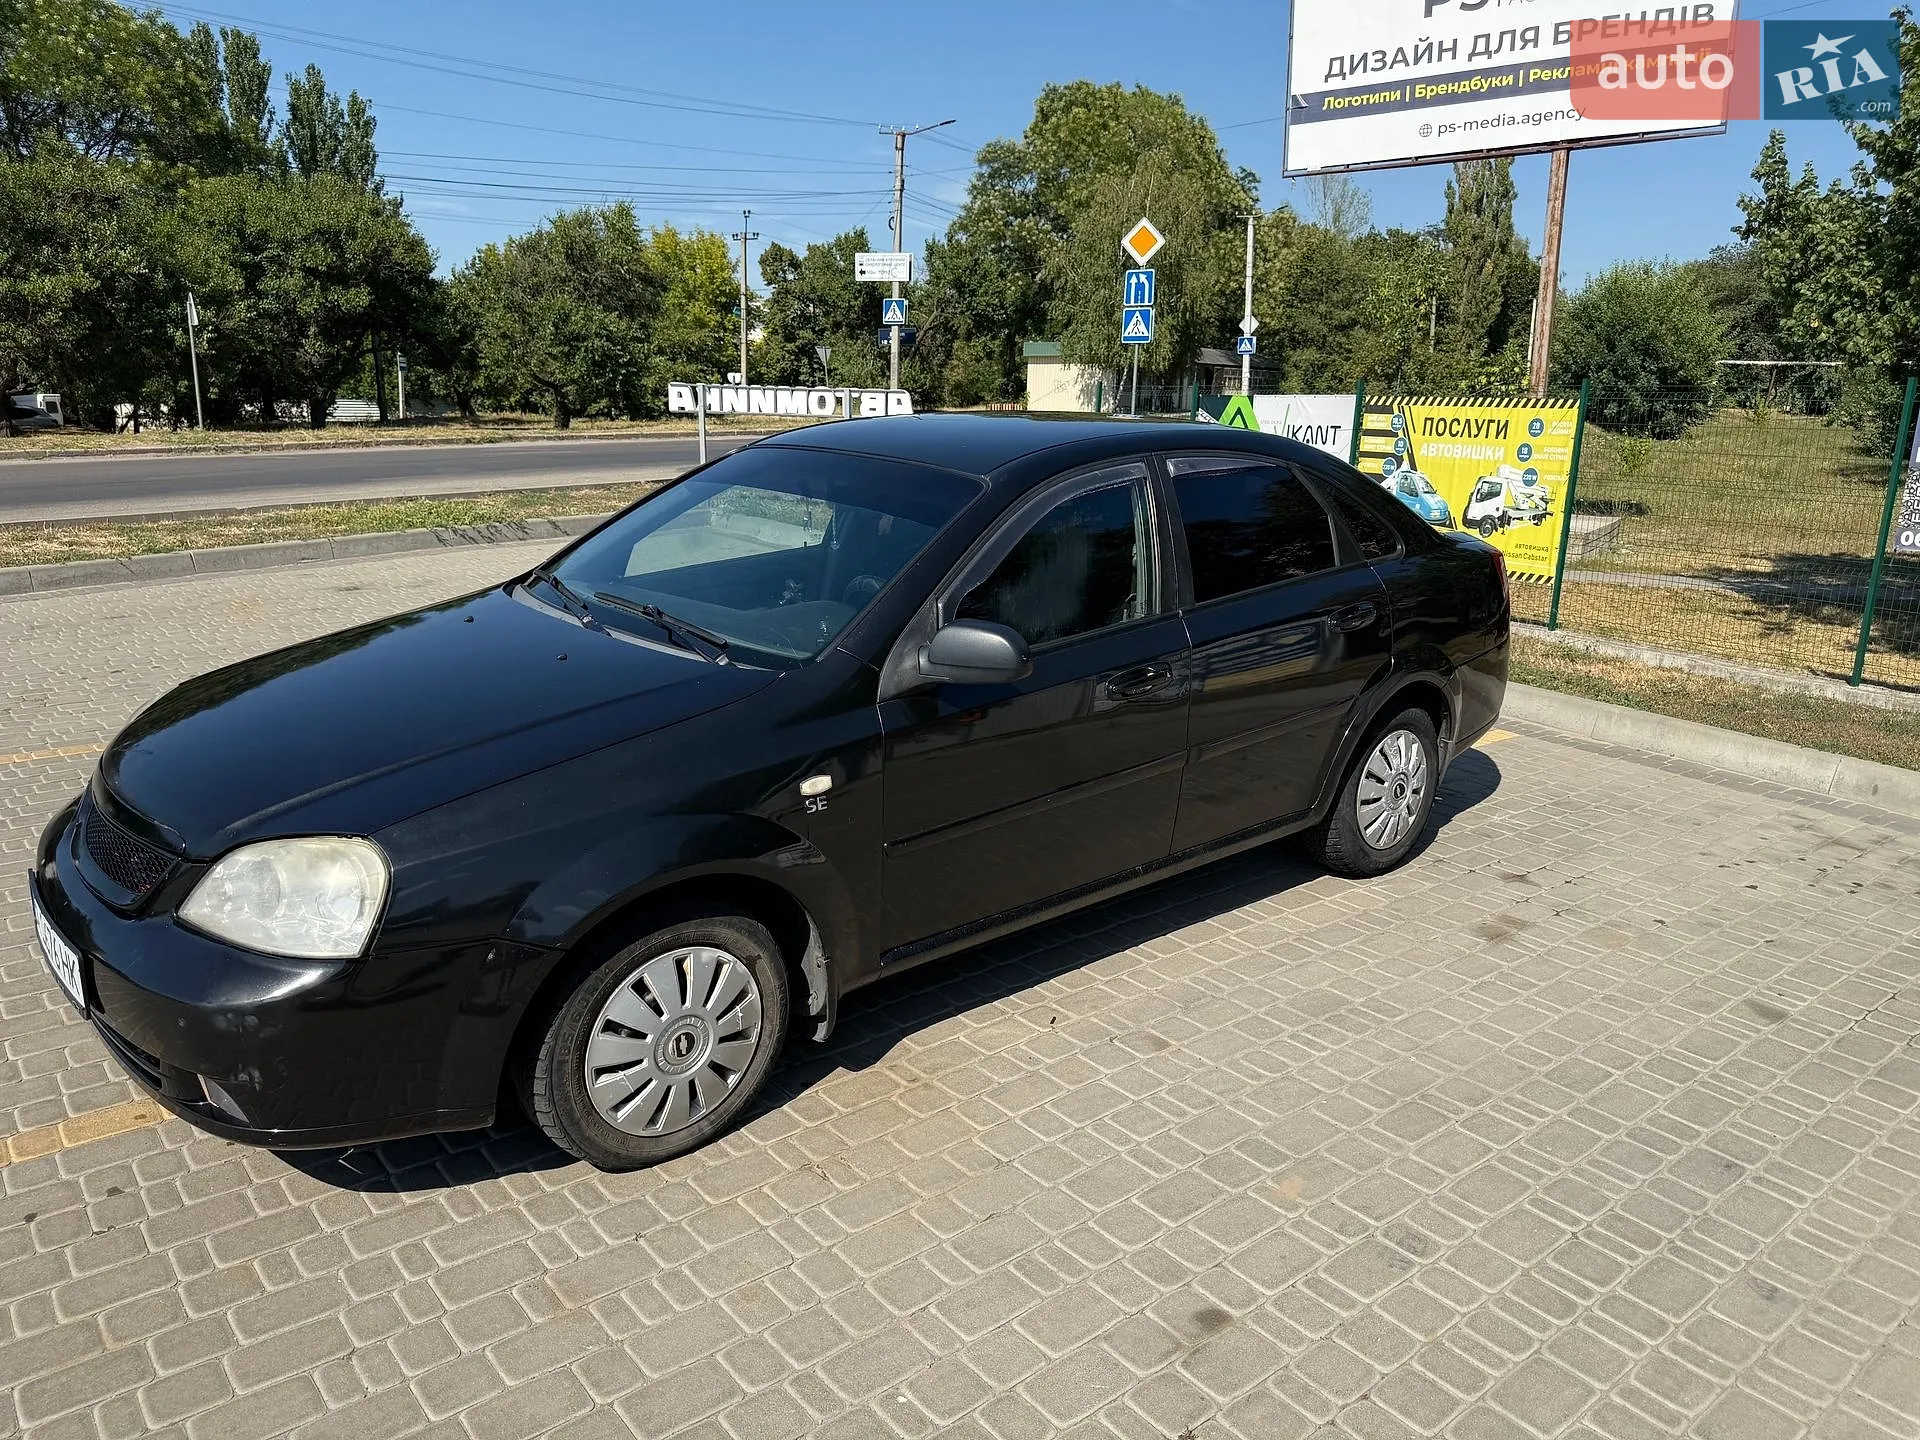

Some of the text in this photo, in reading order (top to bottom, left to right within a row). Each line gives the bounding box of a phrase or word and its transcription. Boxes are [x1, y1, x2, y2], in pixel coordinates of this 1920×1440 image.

[1324, 3, 1715, 83] ДИЗАЙН ДЛЯ БРЕНДІВ
[1322, 89, 1401, 111] Логотипи
[1415, 74, 1514, 100] Брендбуки
[1438, 107, 1587, 137] ps-media.agency
[1421, 416, 1509, 440] ПОСЛУГИ
[1420, 442, 1504, 461] АВТОВИШКИ
[1514, 543, 1549, 552] автовишка
[1523, 552, 1548, 562] Cabstar
[805, 795, 828, 814] SE
